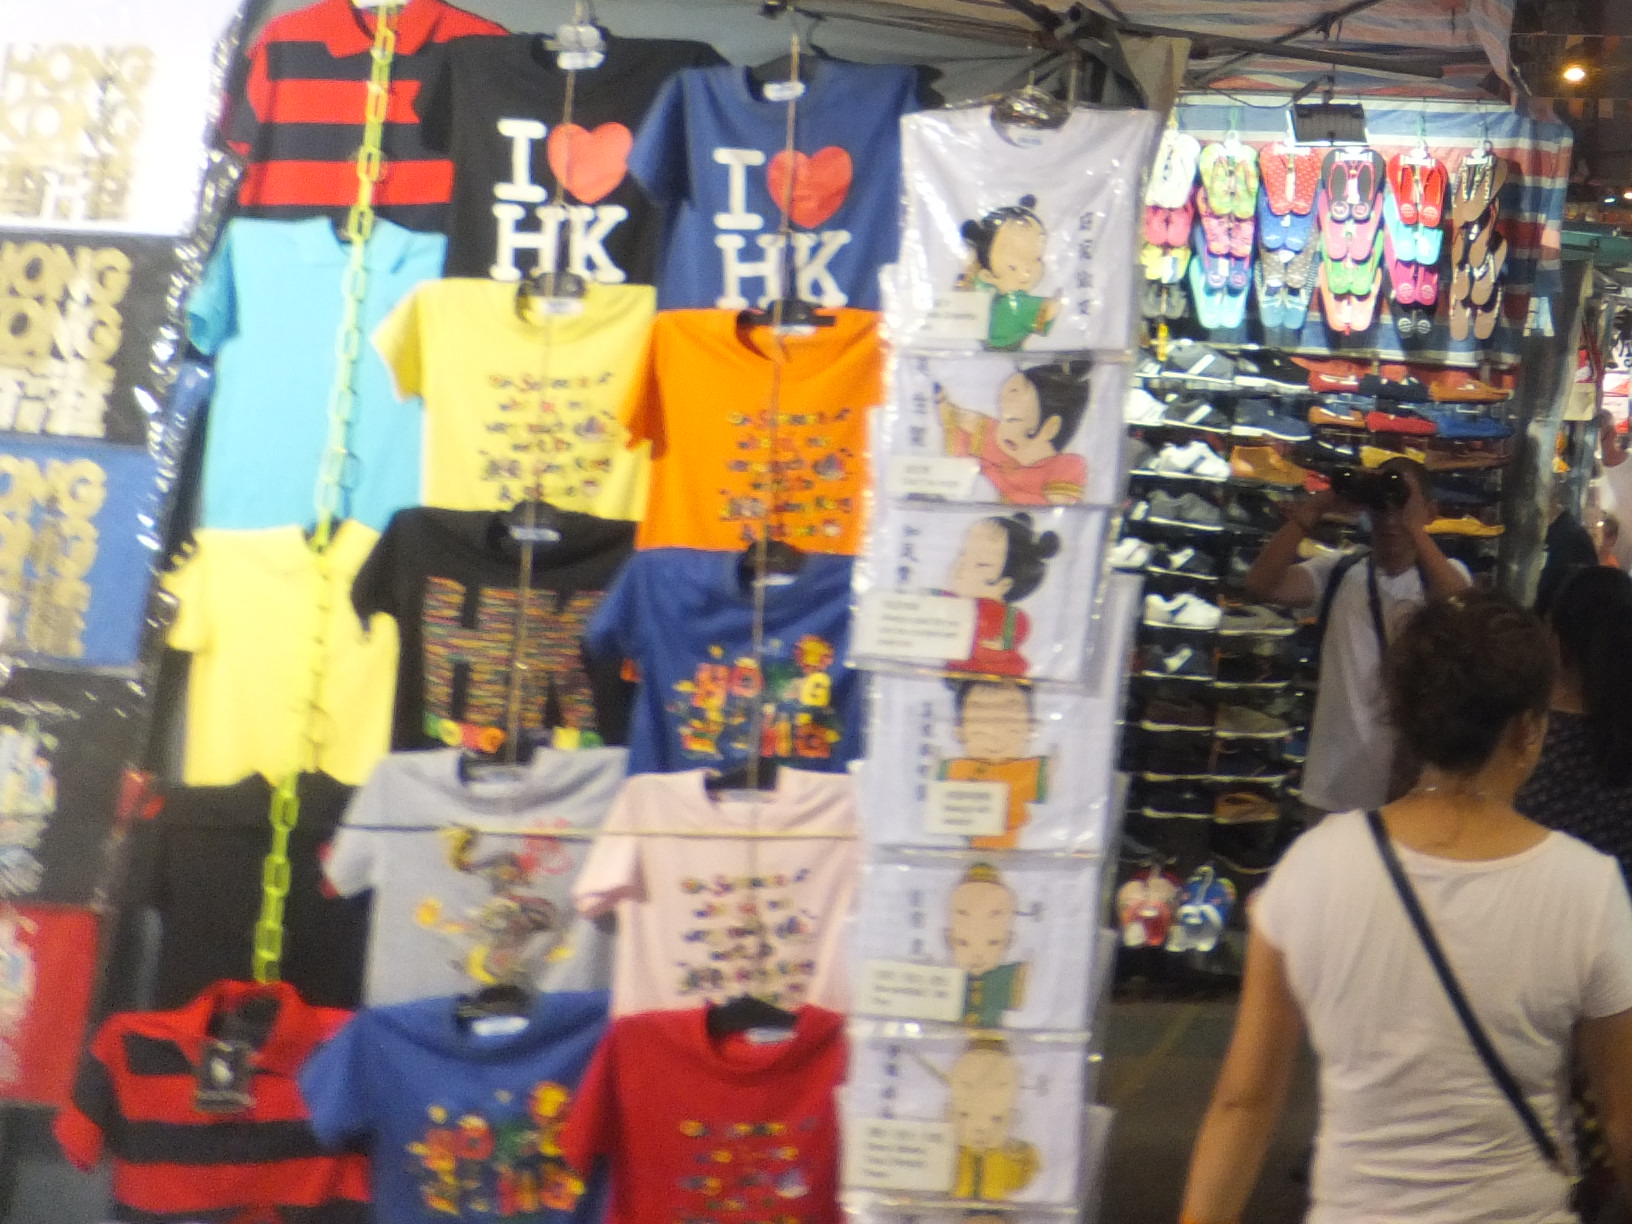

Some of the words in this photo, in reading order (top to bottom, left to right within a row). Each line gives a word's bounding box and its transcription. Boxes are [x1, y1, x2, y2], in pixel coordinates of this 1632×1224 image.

[496, 119, 547, 203] I
[713, 148, 764, 230] I
[490, 204, 628, 283] HK
[712, 234, 850, 309] HK
